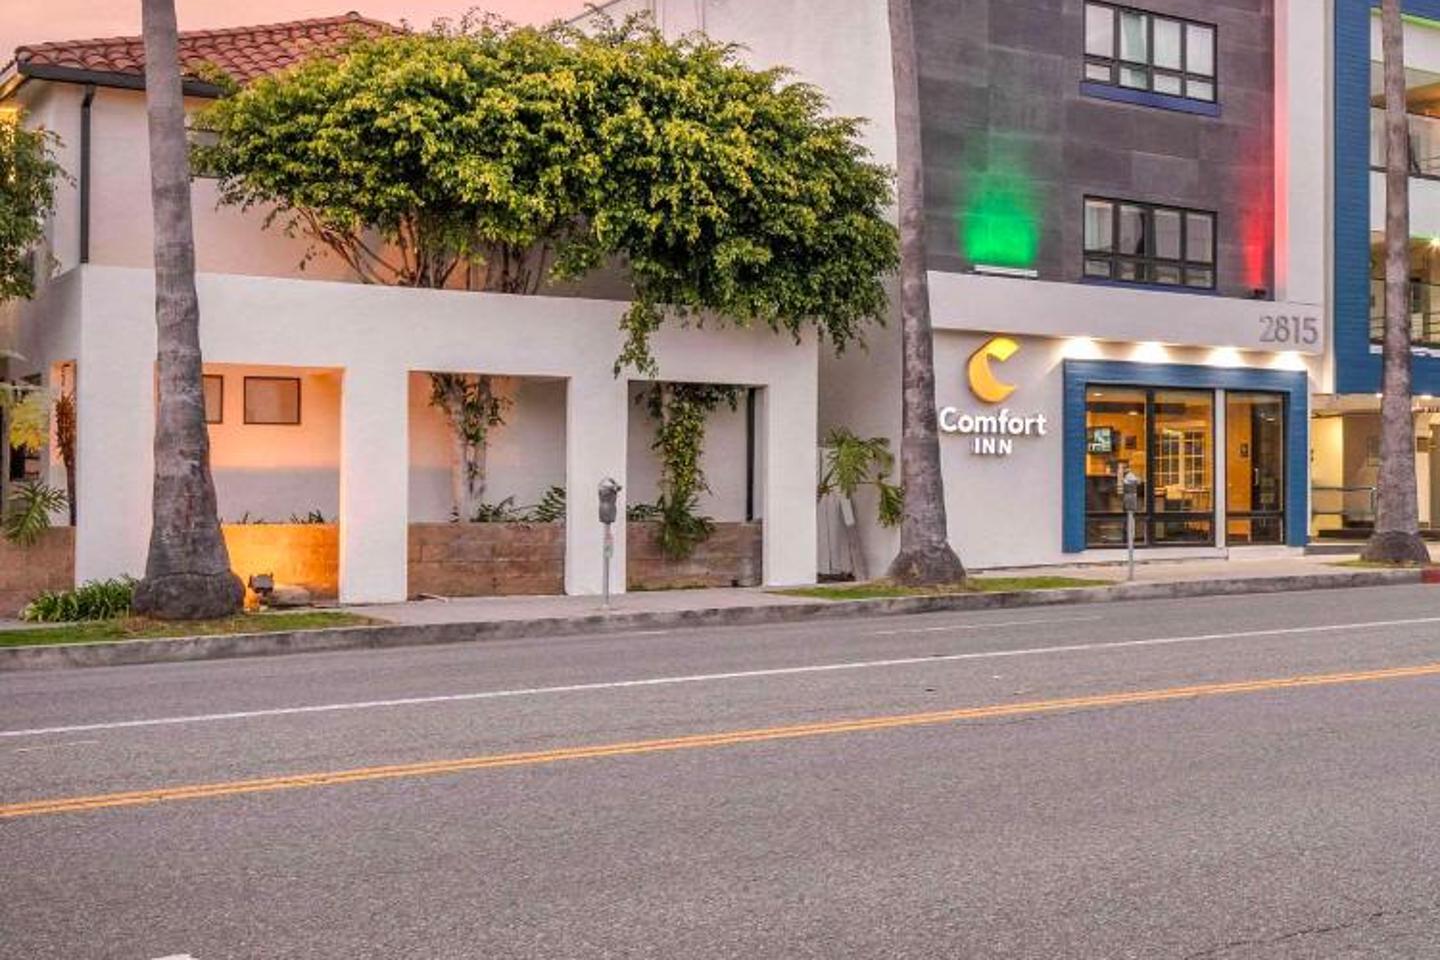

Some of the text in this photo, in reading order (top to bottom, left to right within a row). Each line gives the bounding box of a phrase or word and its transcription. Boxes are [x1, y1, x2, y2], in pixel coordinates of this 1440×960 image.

[1259, 315, 1318, 344] 2815
[939, 406, 1047, 435] Comfort
[974, 437, 1013, 455] INN
